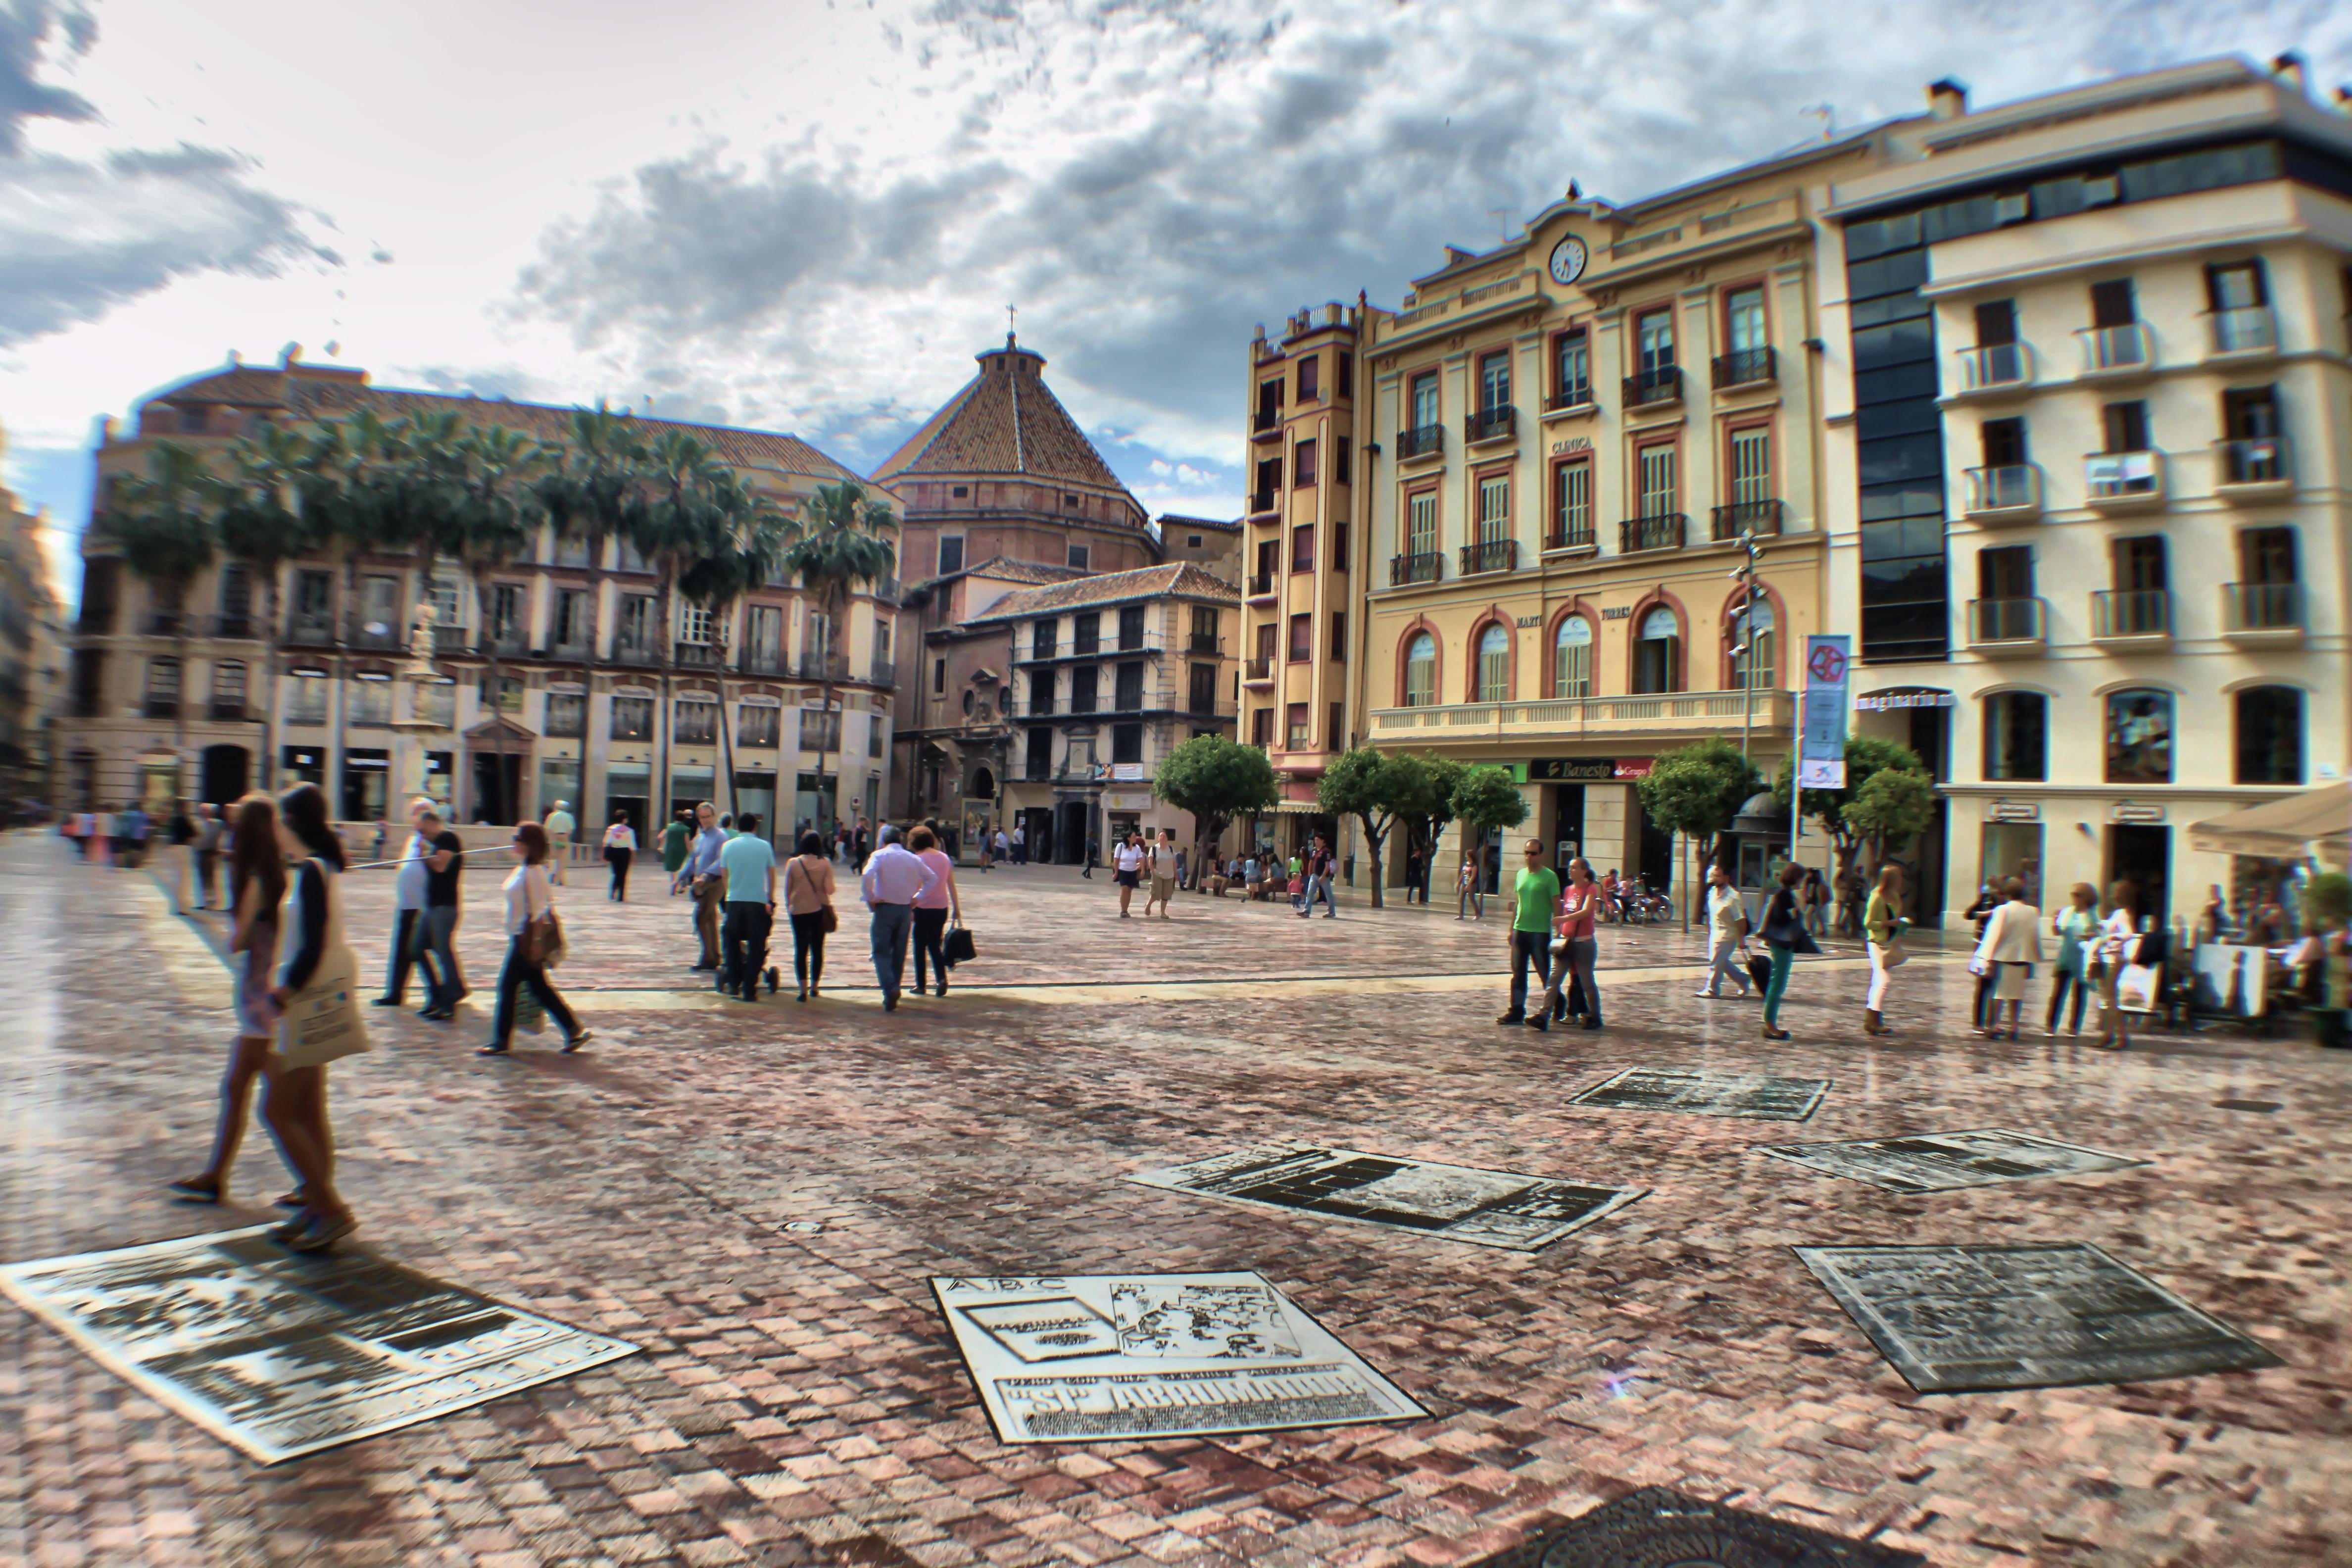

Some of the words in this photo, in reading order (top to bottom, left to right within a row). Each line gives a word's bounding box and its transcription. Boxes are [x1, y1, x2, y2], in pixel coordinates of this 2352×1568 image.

[1601, 605, 1631, 620] TORRES
[1563, 761, 1611, 779] Banesto
[1624, 766, 1647, 779] Grupo
[945, 1278, 1068, 1292] ABC
[1110, 1375, 1368, 1410] ABRUMADOR
